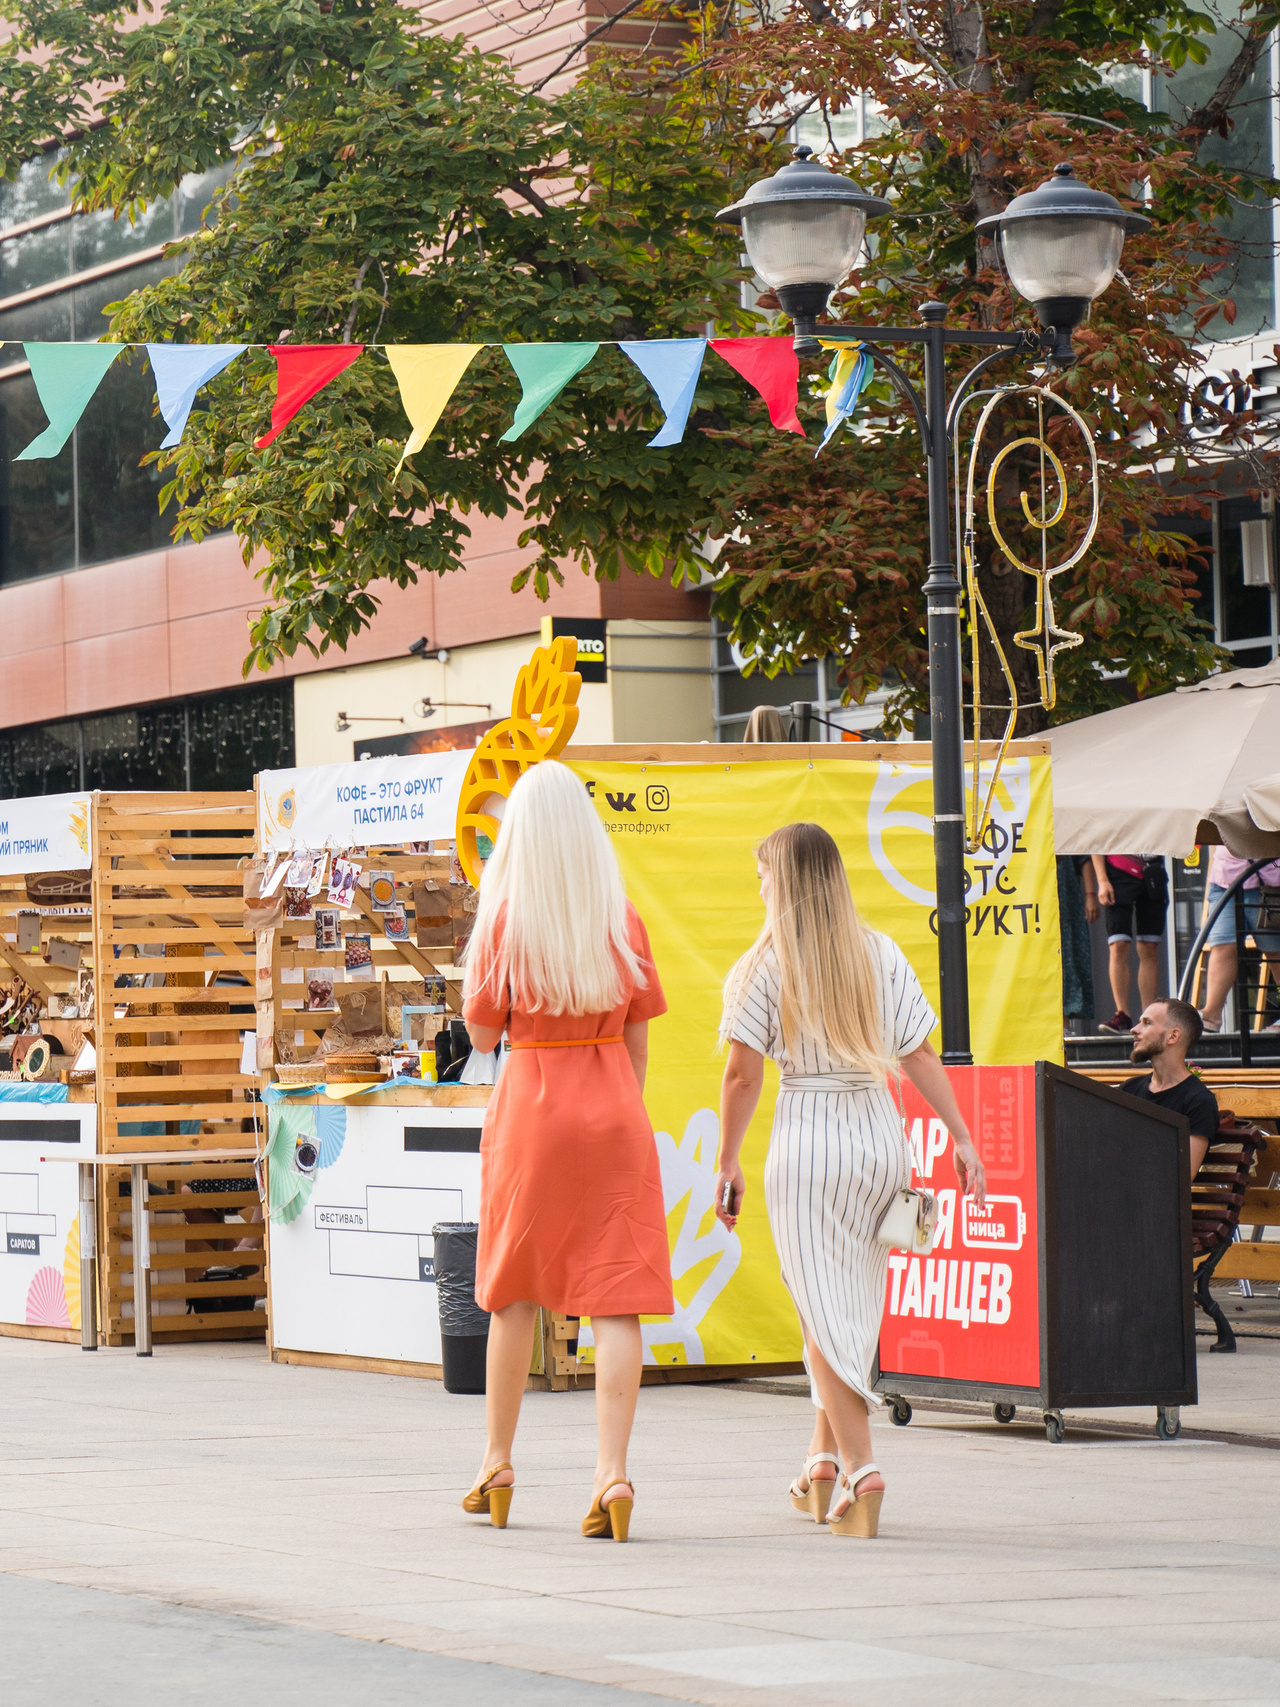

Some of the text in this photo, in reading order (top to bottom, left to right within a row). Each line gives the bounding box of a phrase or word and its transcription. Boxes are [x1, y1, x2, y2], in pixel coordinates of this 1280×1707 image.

[336, 785, 368, 803] КОФЕ
[378, 782, 402, 799] ЭТО
[404, 777, 443, 796] ФРУКТ
[353, 803, 424, 825] ПАСТИЛА 64
[13, 838, 49, 856] ПРЯНИК
[902, 1117, 949, 1178] АР
[320, 1213, 363, 1225] ФЕСТИВАЛЬ
[968, 1221, 1006, 1240] ница
[9, 1238, 36, 1250] САРАТОВ
[888, 1255, 1013, 1329] ТАНЦЕВ
